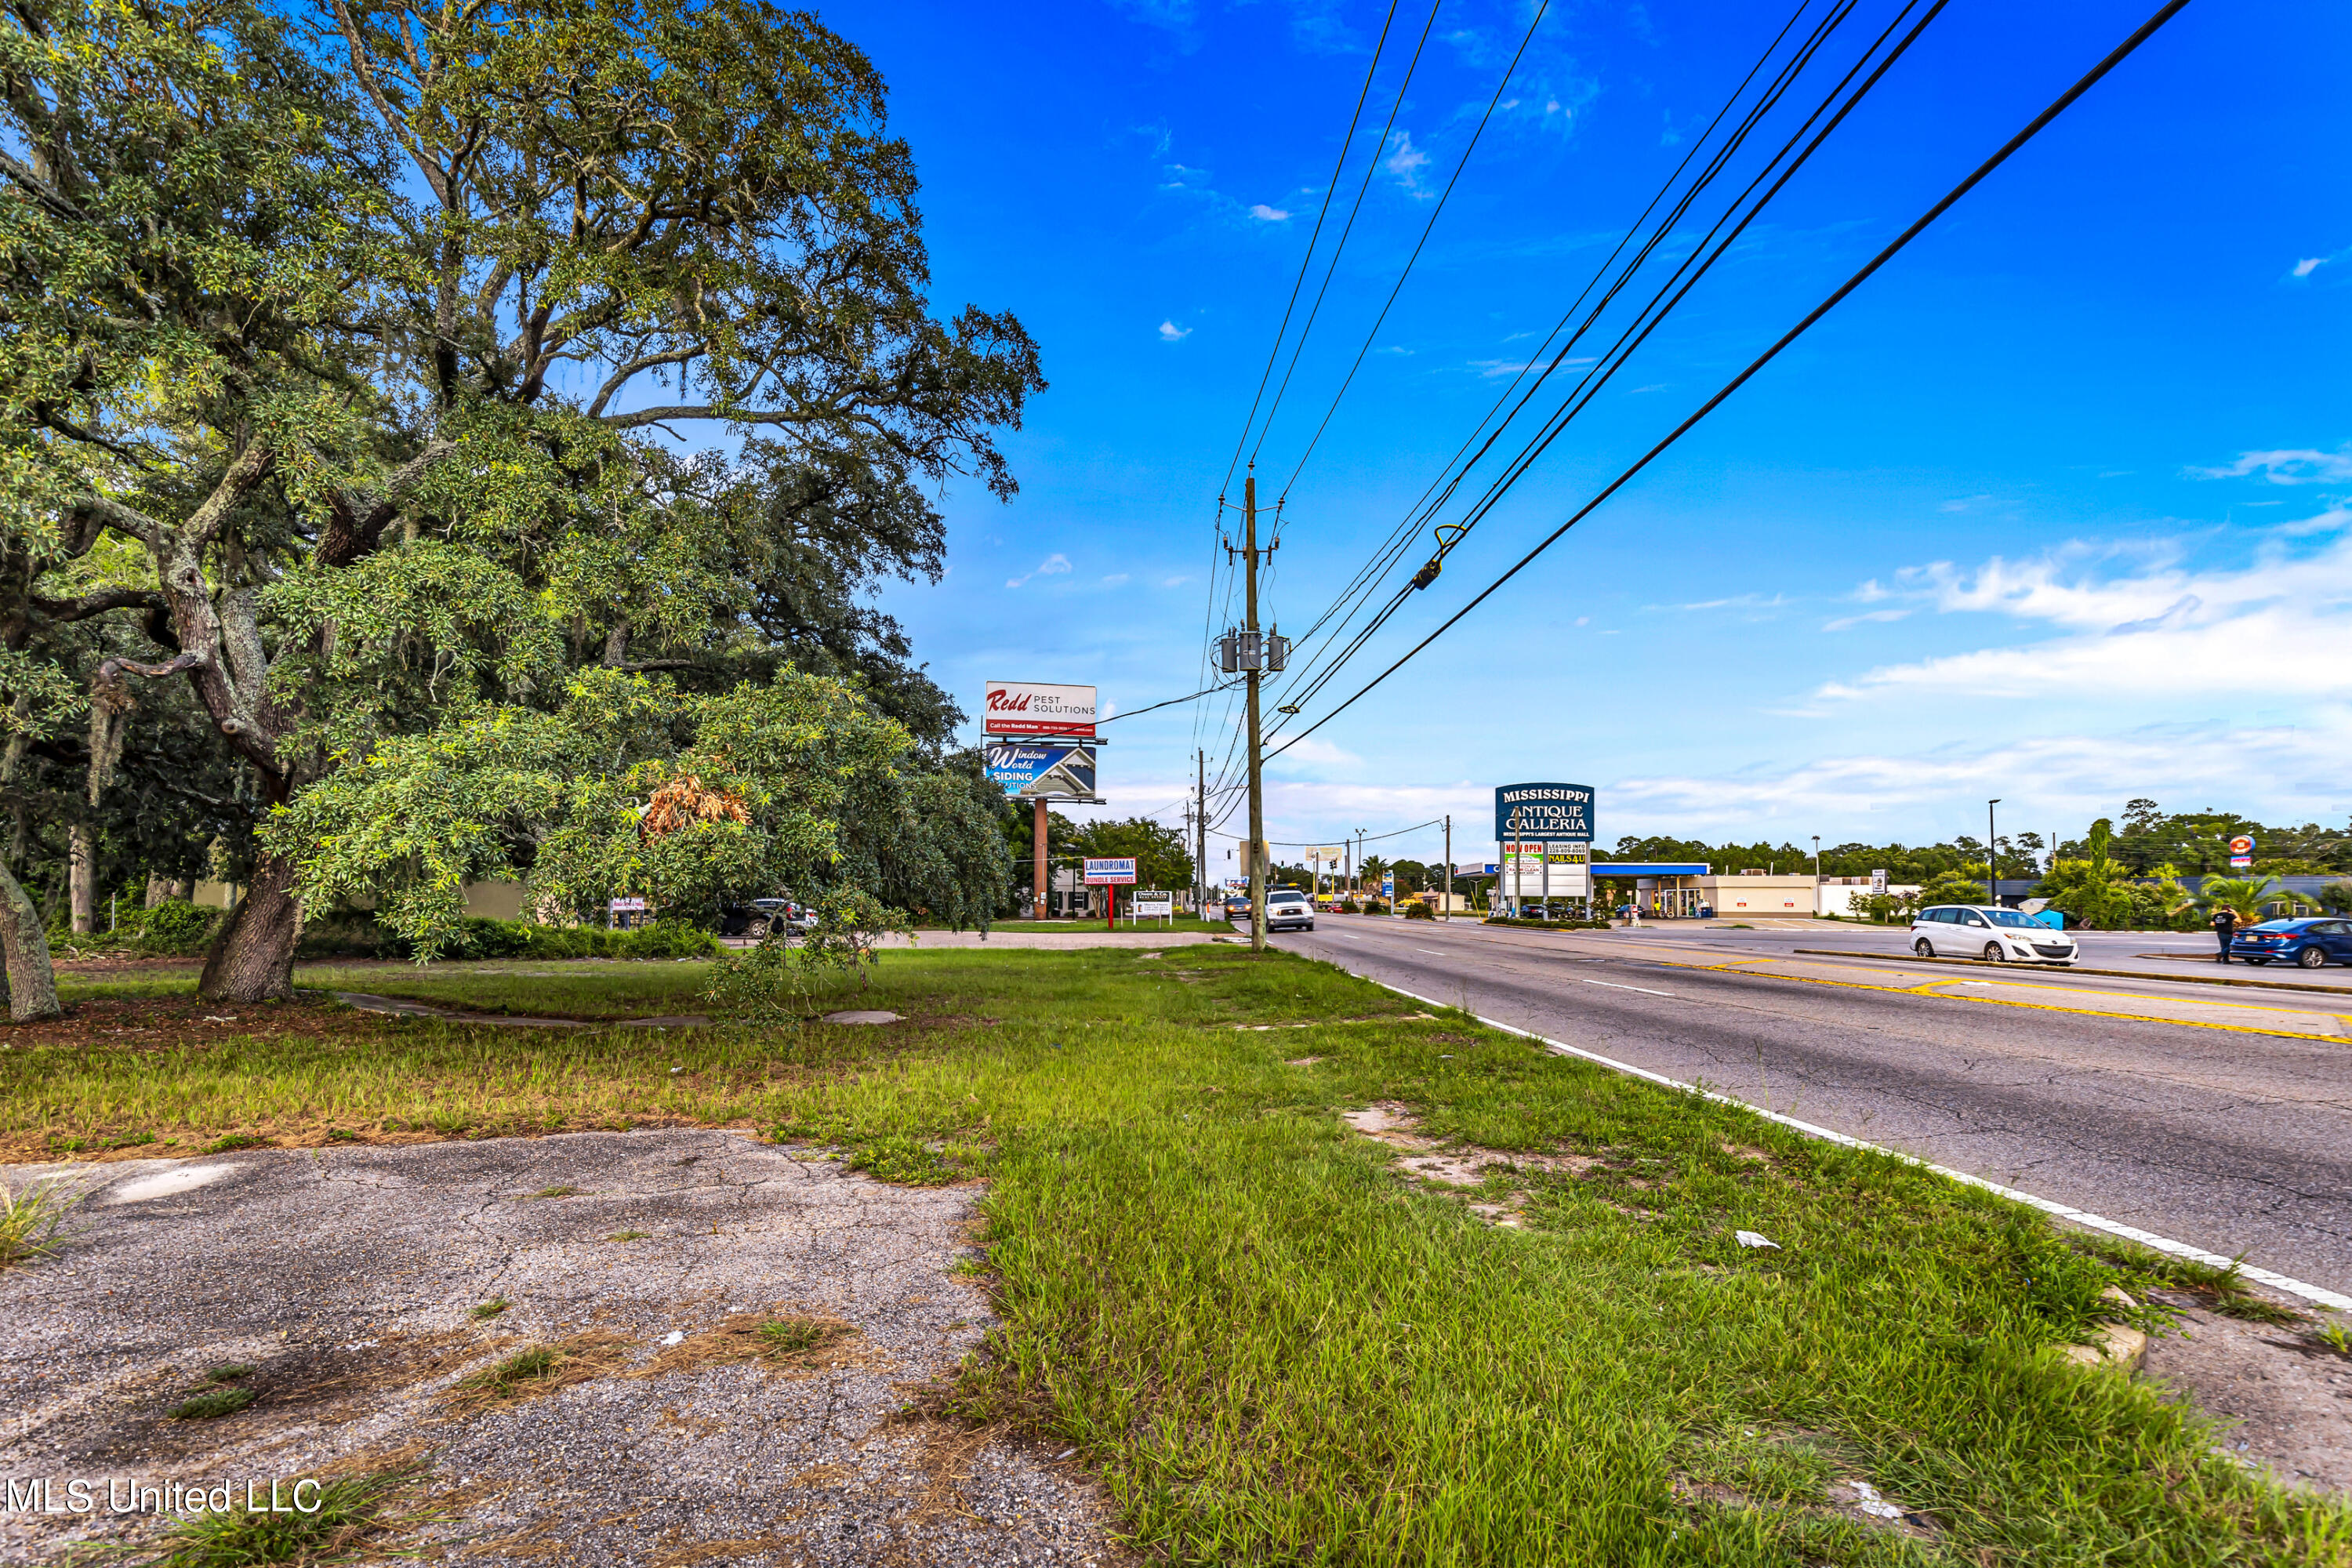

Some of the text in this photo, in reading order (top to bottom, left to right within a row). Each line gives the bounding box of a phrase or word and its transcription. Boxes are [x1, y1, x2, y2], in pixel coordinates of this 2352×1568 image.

[986, 689, 1033, 712] Redd
[1034, 695, 1061, 704] PEST
[1034, 705, 1095, 715] SOLUTIONS
[994, 771, 1033, 782] SIDING
[1504, 789, 1591, 804] MISSISSIPPI
[1510, 806, 1584, 818] ANTIQUE
[1524, 844, 1542, 853] OPEN
[1085, 860, 1134, 870] LAUNDROMAT
